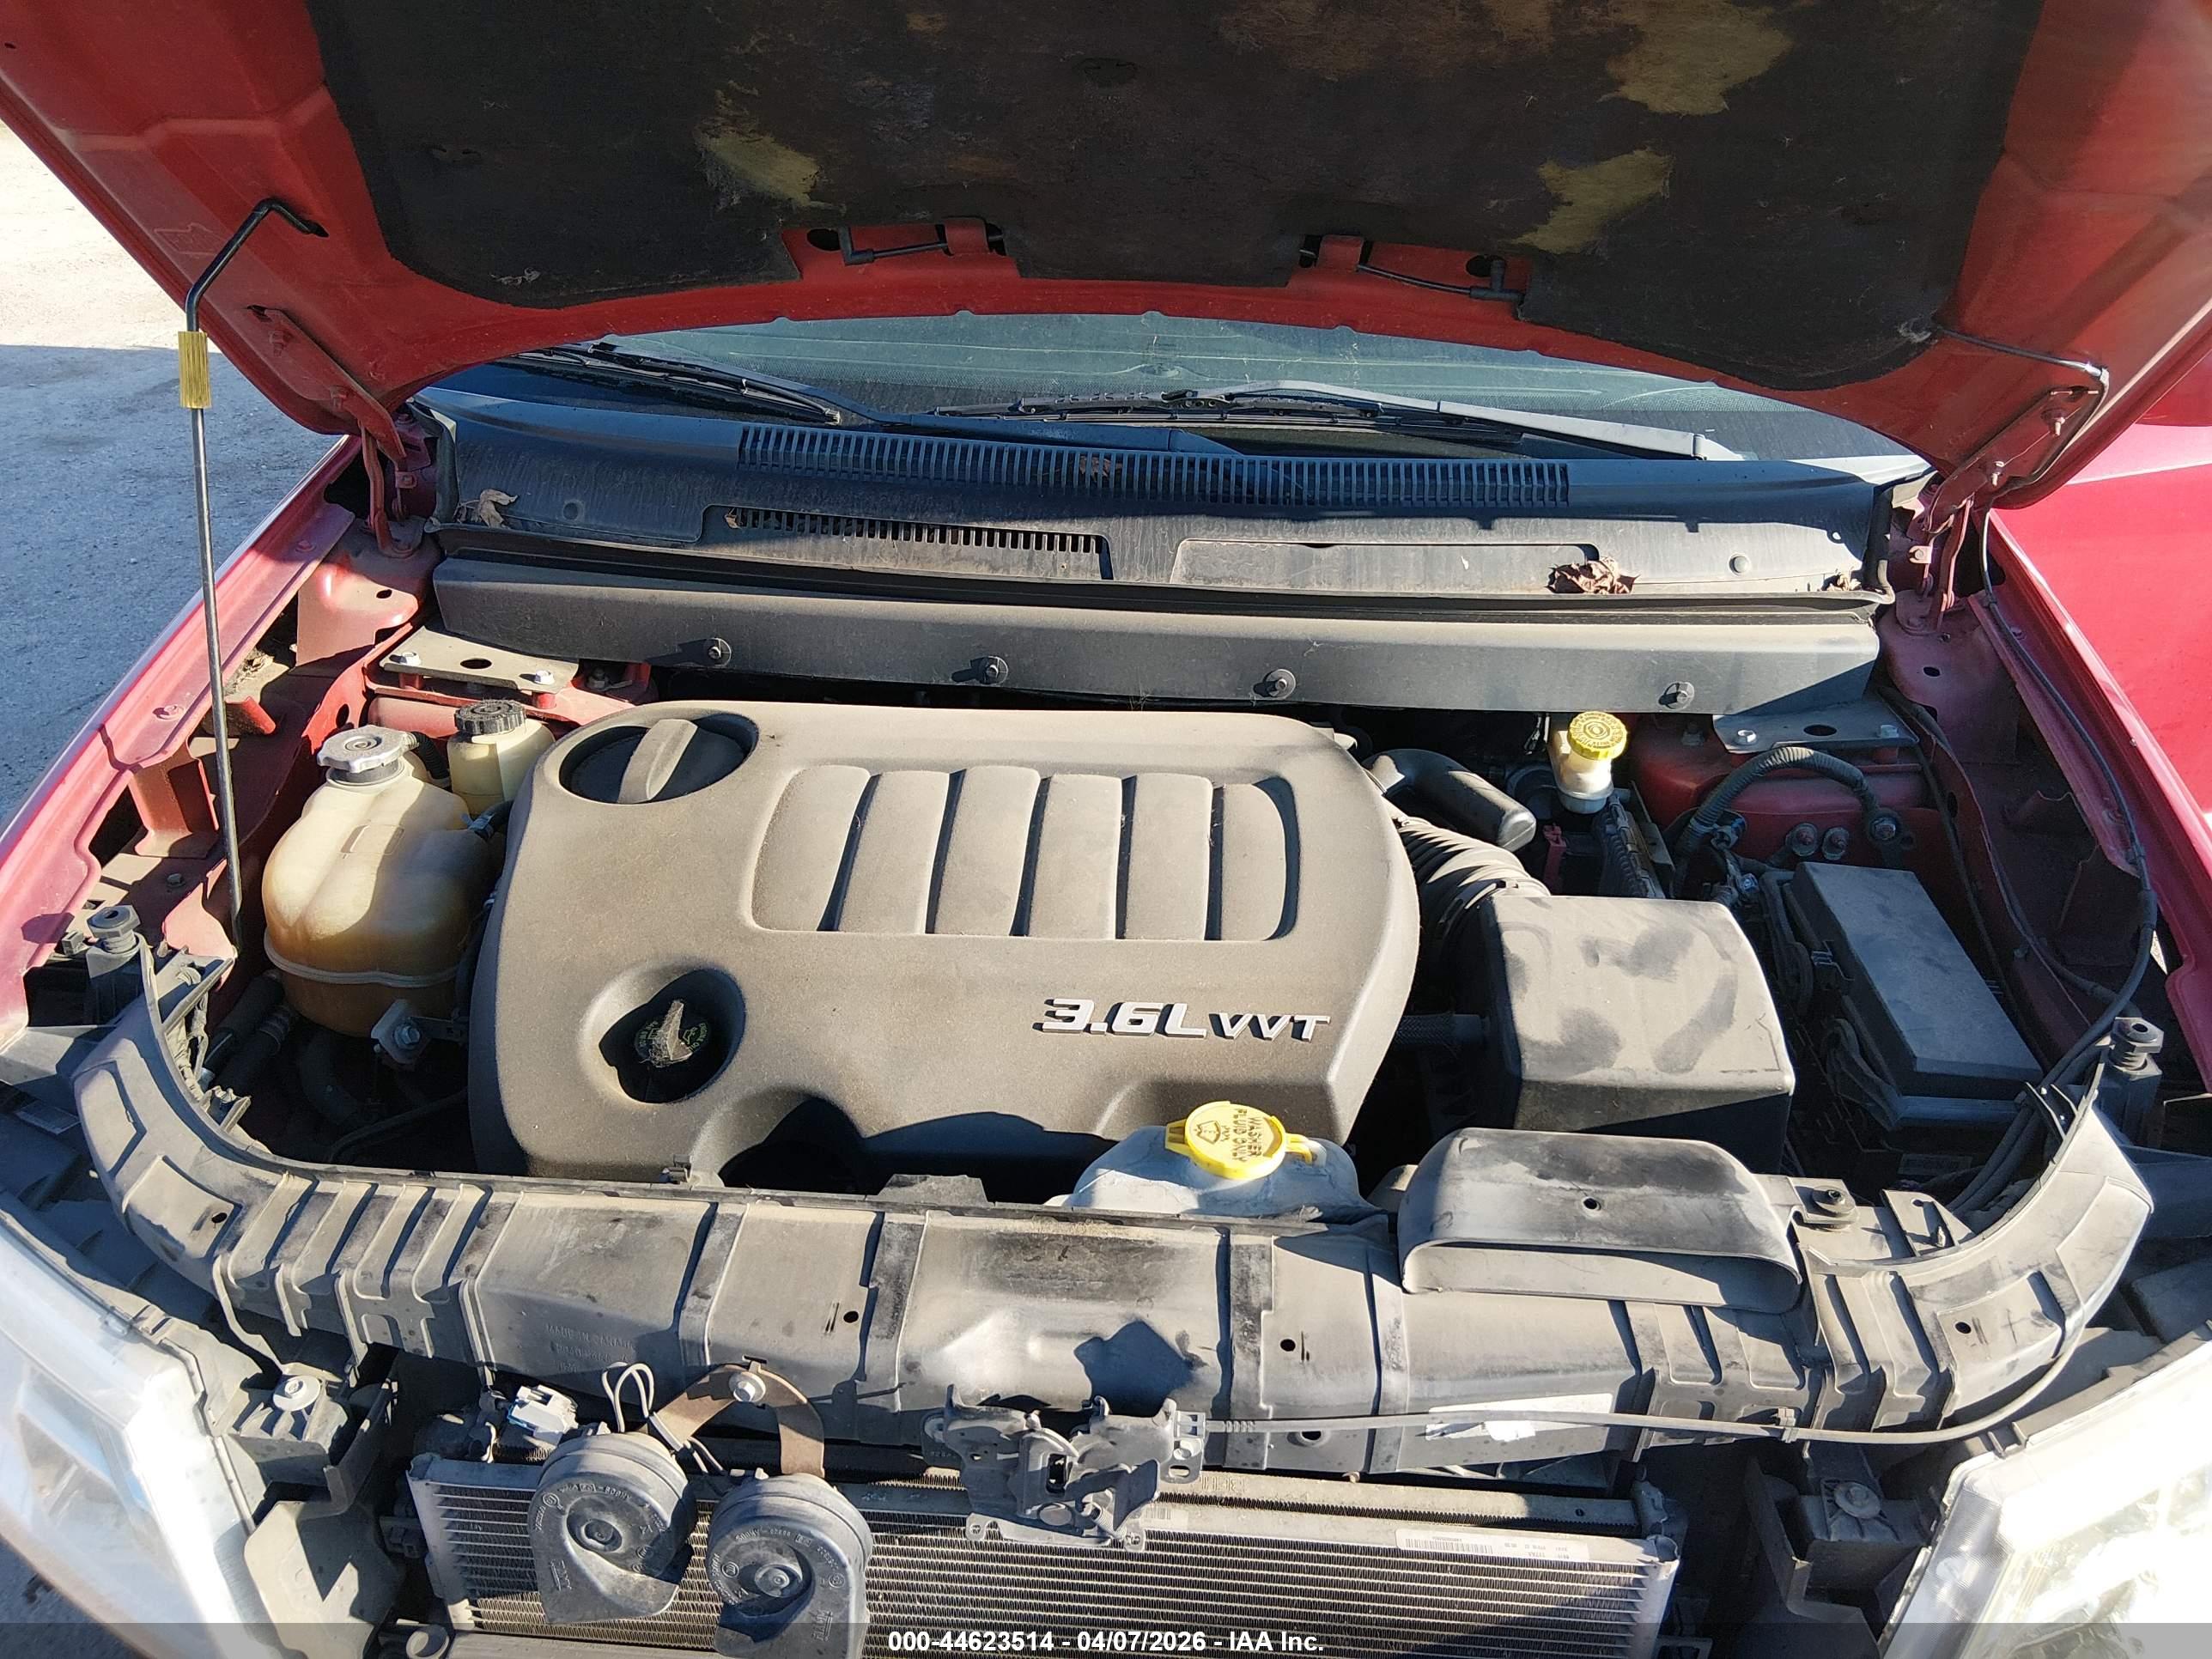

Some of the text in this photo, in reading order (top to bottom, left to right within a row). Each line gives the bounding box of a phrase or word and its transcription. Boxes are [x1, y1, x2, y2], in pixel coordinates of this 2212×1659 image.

[1041, 998, 1332, 1042] 3.6L VVT
[1232, 1109, 1248, 1163] FLUID ONLY
[1248, 1116, 1262, 1158] WASHER
